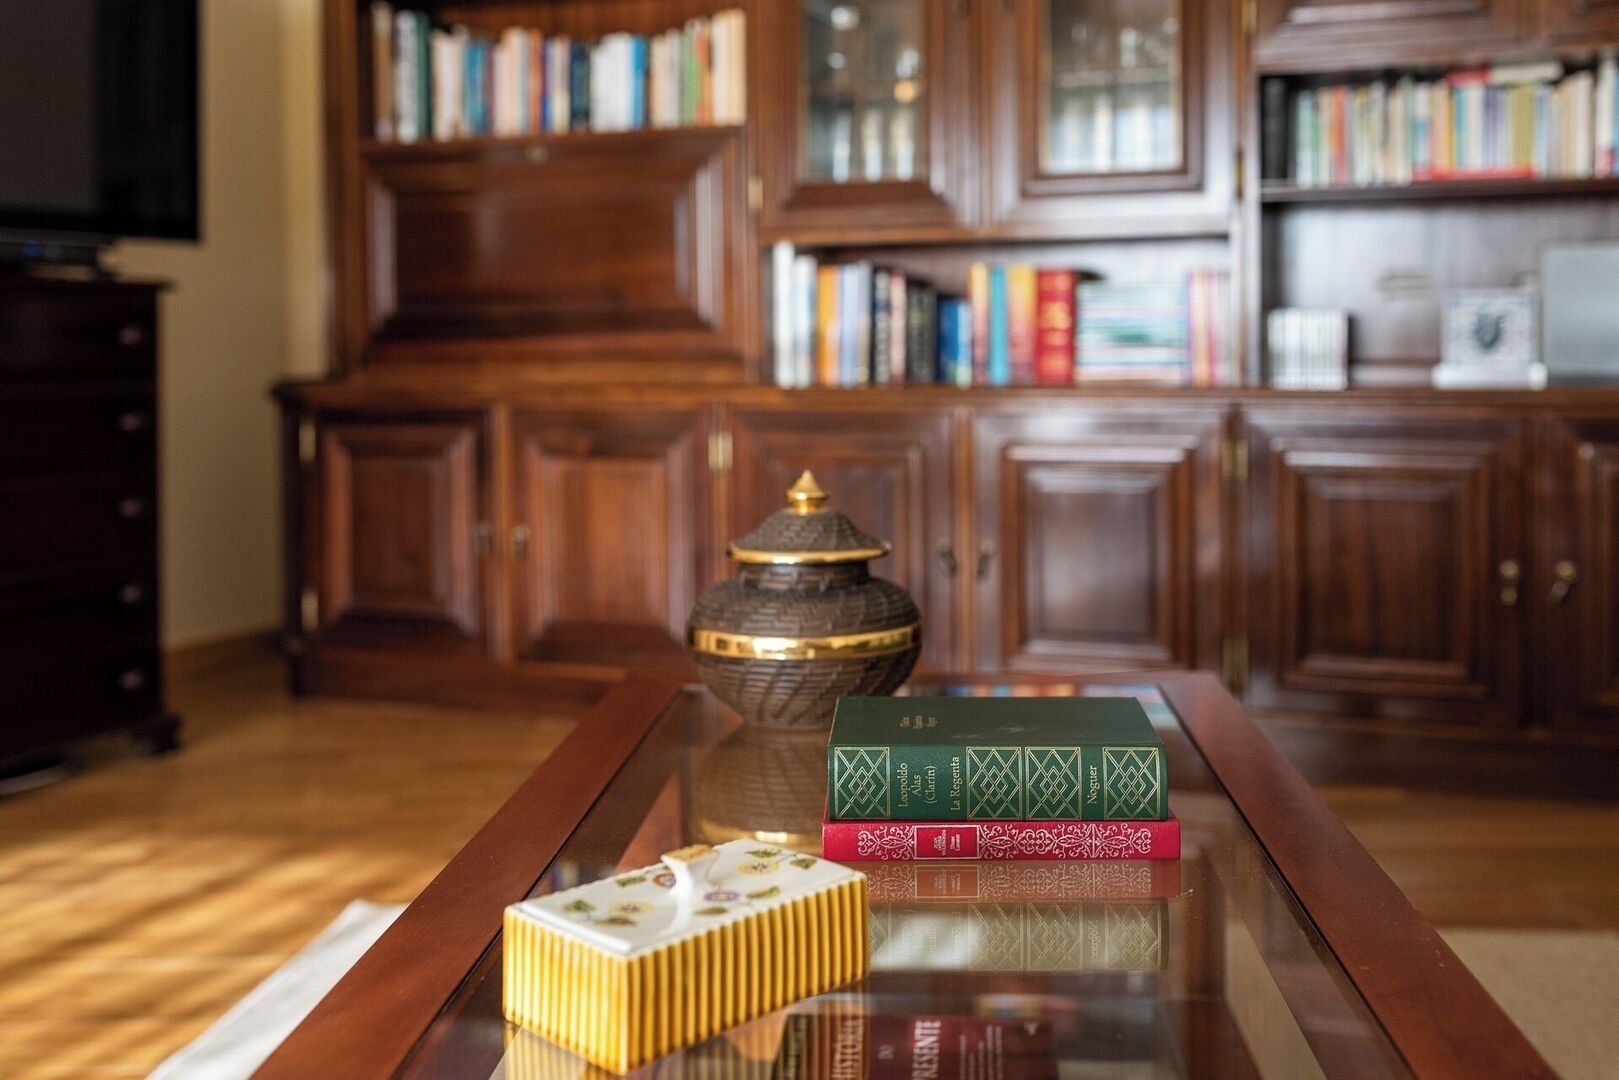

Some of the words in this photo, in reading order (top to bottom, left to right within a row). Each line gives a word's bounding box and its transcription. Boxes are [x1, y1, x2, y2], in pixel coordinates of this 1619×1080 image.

[897, 762, 910, 807] Leopoldo
[911, 774, 921, 797] Alas
[950, 756, 963, 798] Regenta
[1087, 765, 1100, 804] Noguer
[951, 800, 960, 811] La
